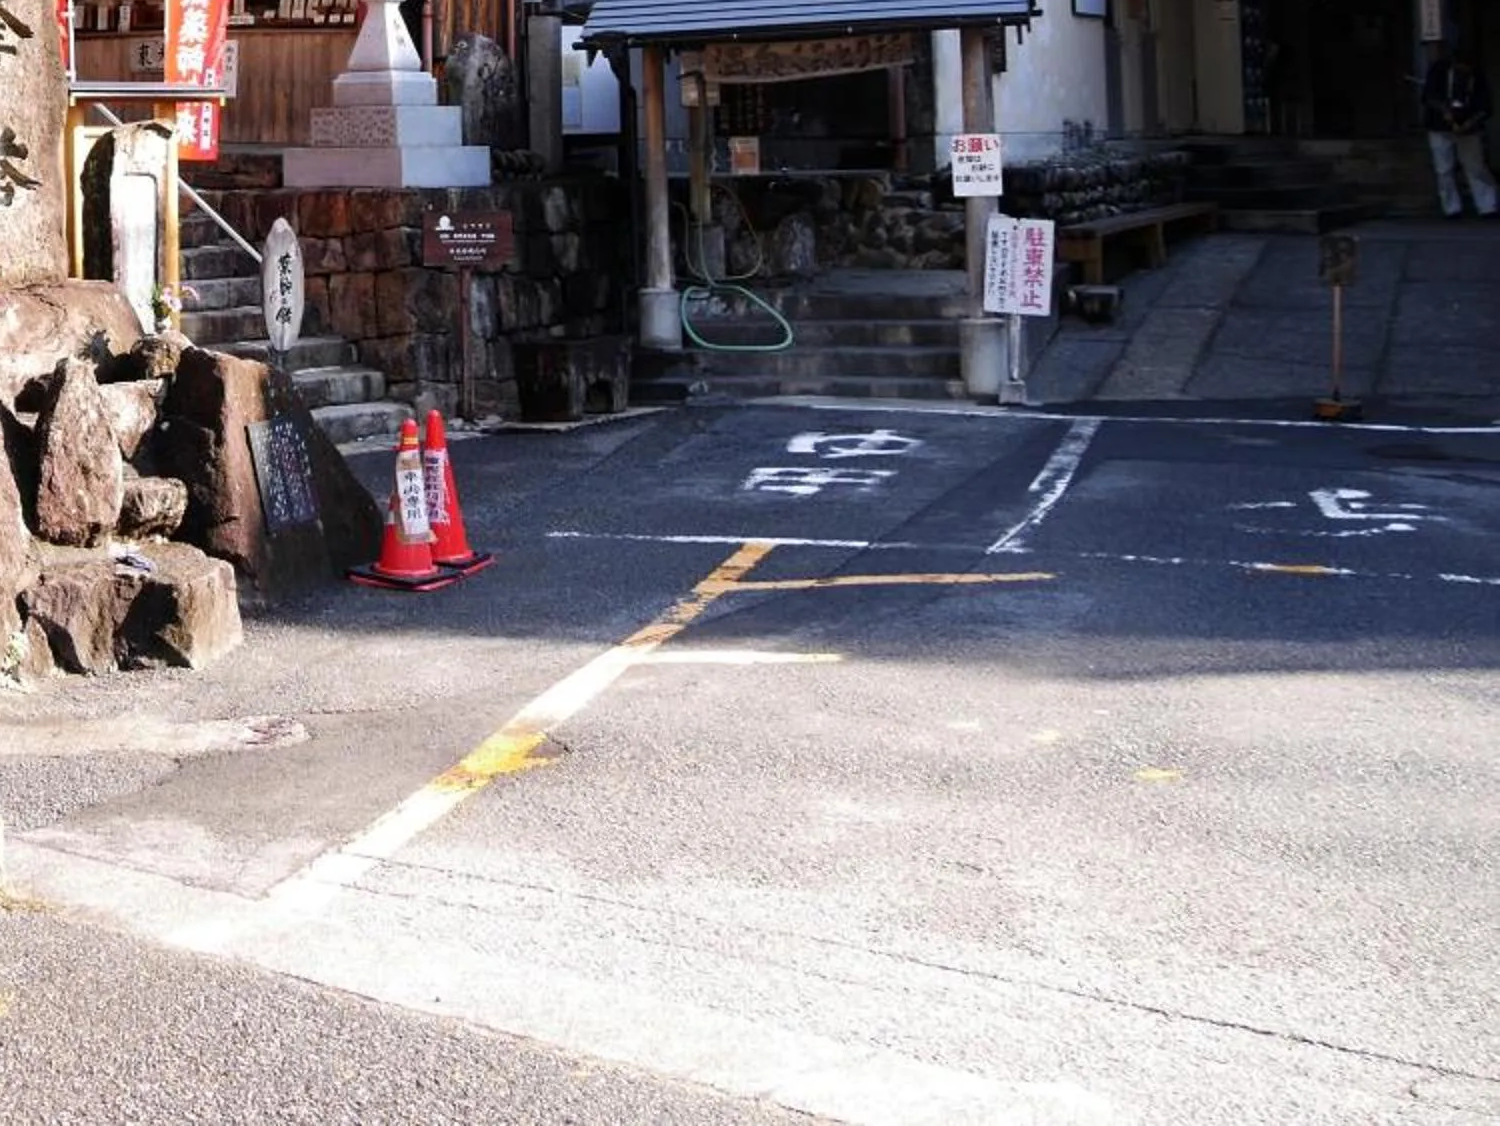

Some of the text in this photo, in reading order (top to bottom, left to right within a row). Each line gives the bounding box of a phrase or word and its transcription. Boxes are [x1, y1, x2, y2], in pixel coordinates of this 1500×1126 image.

[951, 137, 999, 153] お願い
[1021, 227, 1046, 309] 駐車禁止
